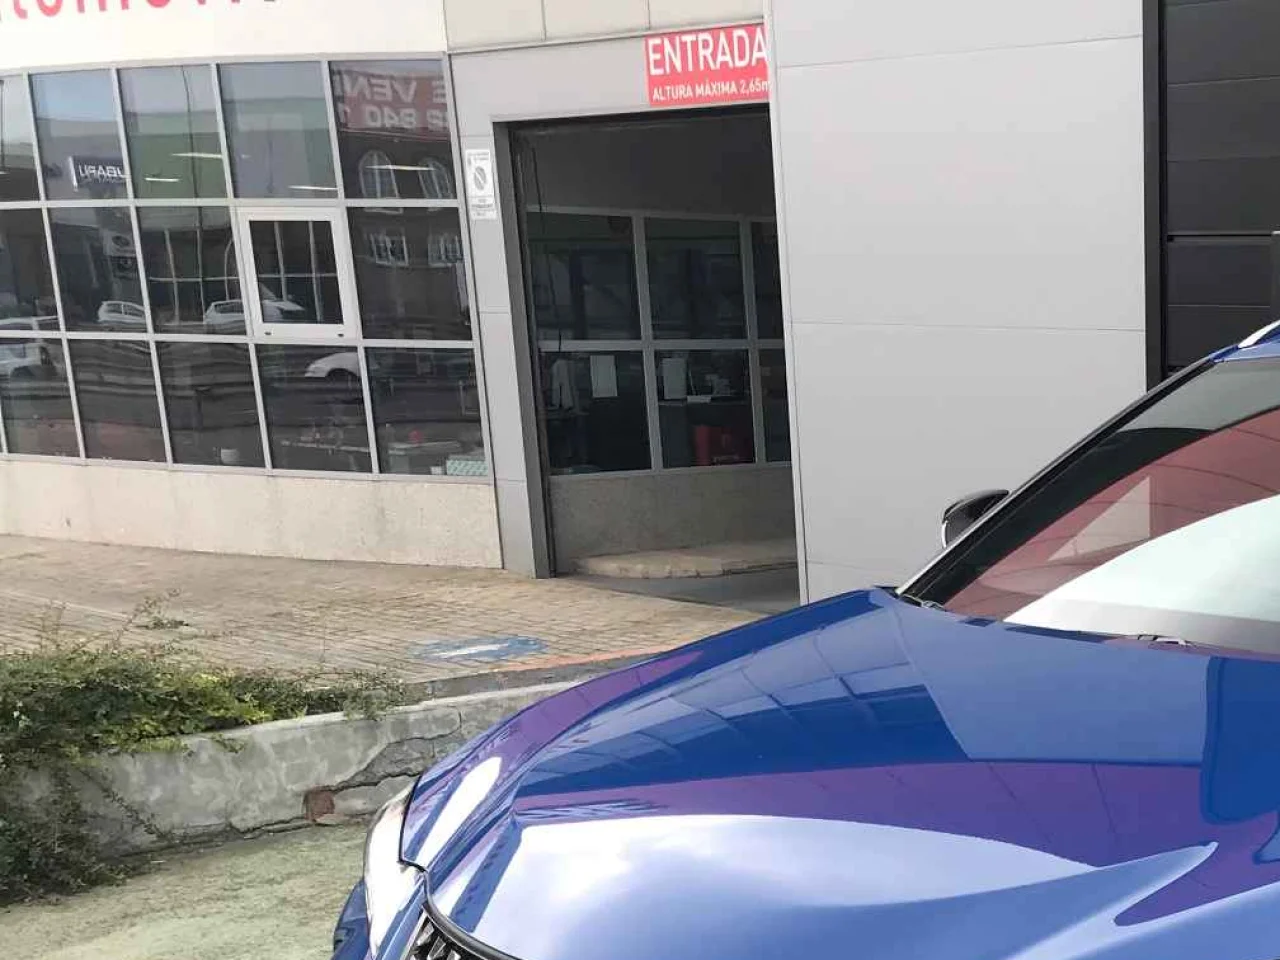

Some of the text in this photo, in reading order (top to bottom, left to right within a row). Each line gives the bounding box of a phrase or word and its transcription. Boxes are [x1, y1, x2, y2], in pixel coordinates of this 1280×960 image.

[647, 27, 770, 76] ENTRADA
[652, 83, 694, 102] ALTURA
[695, 77, 738, 98] MÁXIMA
